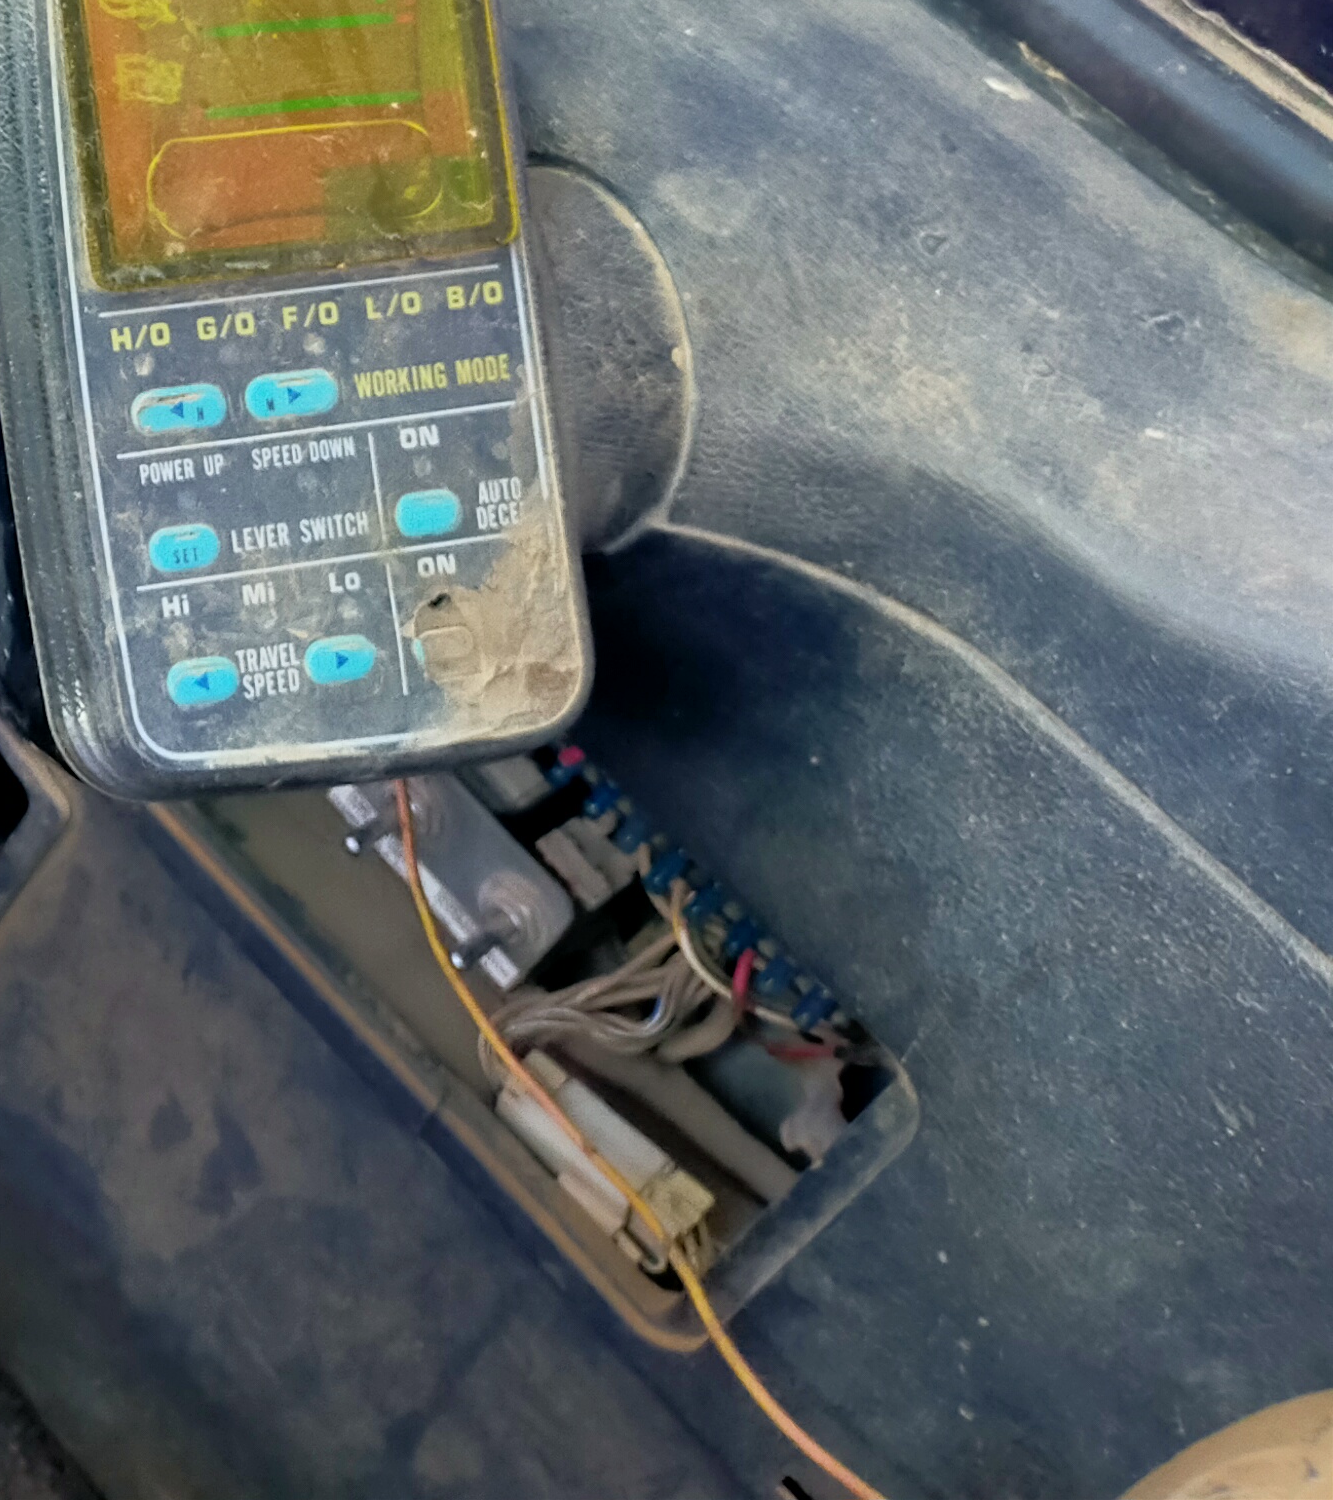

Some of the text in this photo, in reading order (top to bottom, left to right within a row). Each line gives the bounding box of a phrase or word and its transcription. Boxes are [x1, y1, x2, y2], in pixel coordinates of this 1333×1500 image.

[110, 281, 503, 352] H/O G/O F/O L/O B/O
[354, 353, 511, 399] WORKING MODE
[399, 425, 439, 450] ON
[251, 436, 356, 471] SPEED DOWN
[139, 455, 226, 486] POWER UP
[478, 476, 522, 505] AUTO
[476, 501, 524, 530] DECE
[231, 512, 370, 555] LEVER SWITCH
[417, 553, 457, 578] ON
[241, 581, 276, 607] Mi
[328, 570, 361, 594] Lo
[161, 593, 189, 618] Hi
[235, 641, 301, 673] TRAVEL
[242, 669, 300, 699] SPEED
